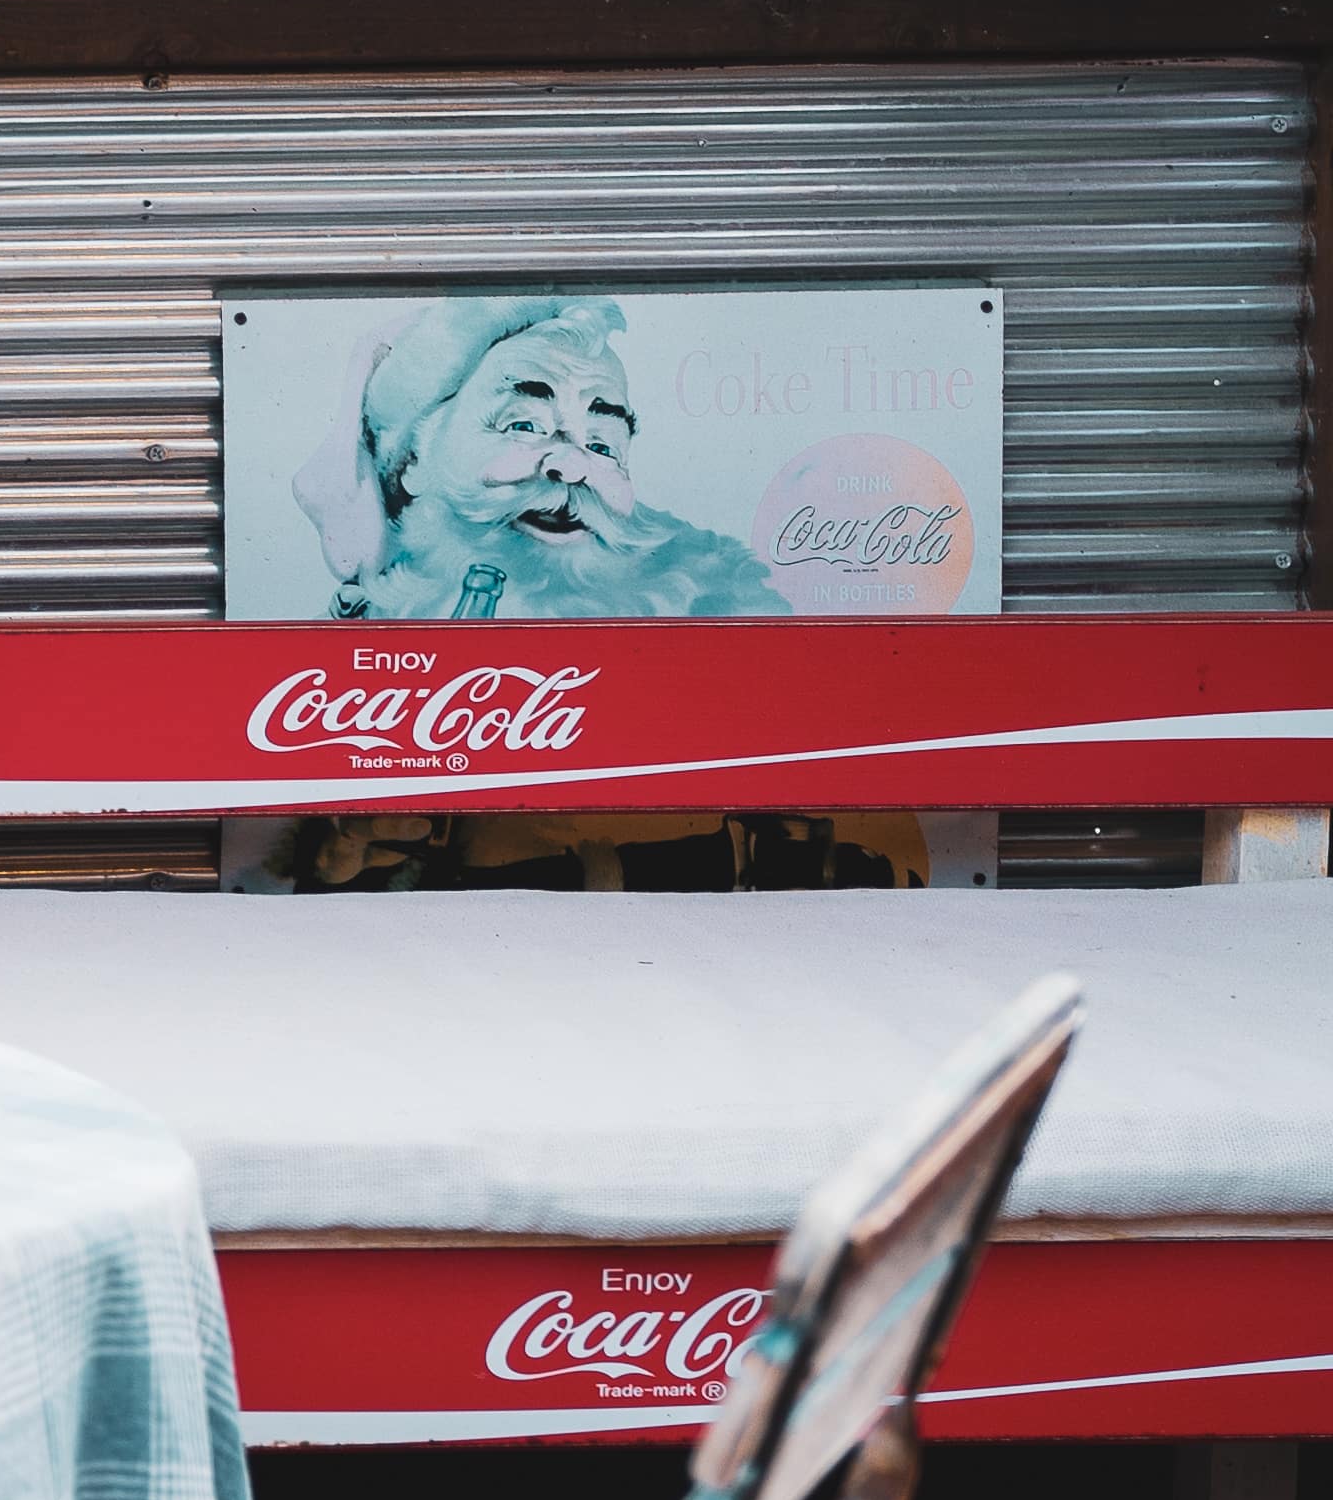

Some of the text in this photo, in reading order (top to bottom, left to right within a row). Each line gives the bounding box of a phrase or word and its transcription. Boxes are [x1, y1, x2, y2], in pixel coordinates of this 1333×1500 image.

[675, 343, 977, 420] Coke Time
[836, 474, 894, 493] DRINK
[769, 503, 963, 566] Coca-Cola
[813, 583, 916, 602] IN BOTTLES
[353, 648, 437, 674] Enjoy
[247, 664, 602, 755] Coca-Cola
[349, 754, 442, 769] Trade-mark
[602, 1268, 692, 1296] Enjoy
[485, 1288, 773, 1381] Coca-C
[596, 1383, 697, 1399] Trade-mark
